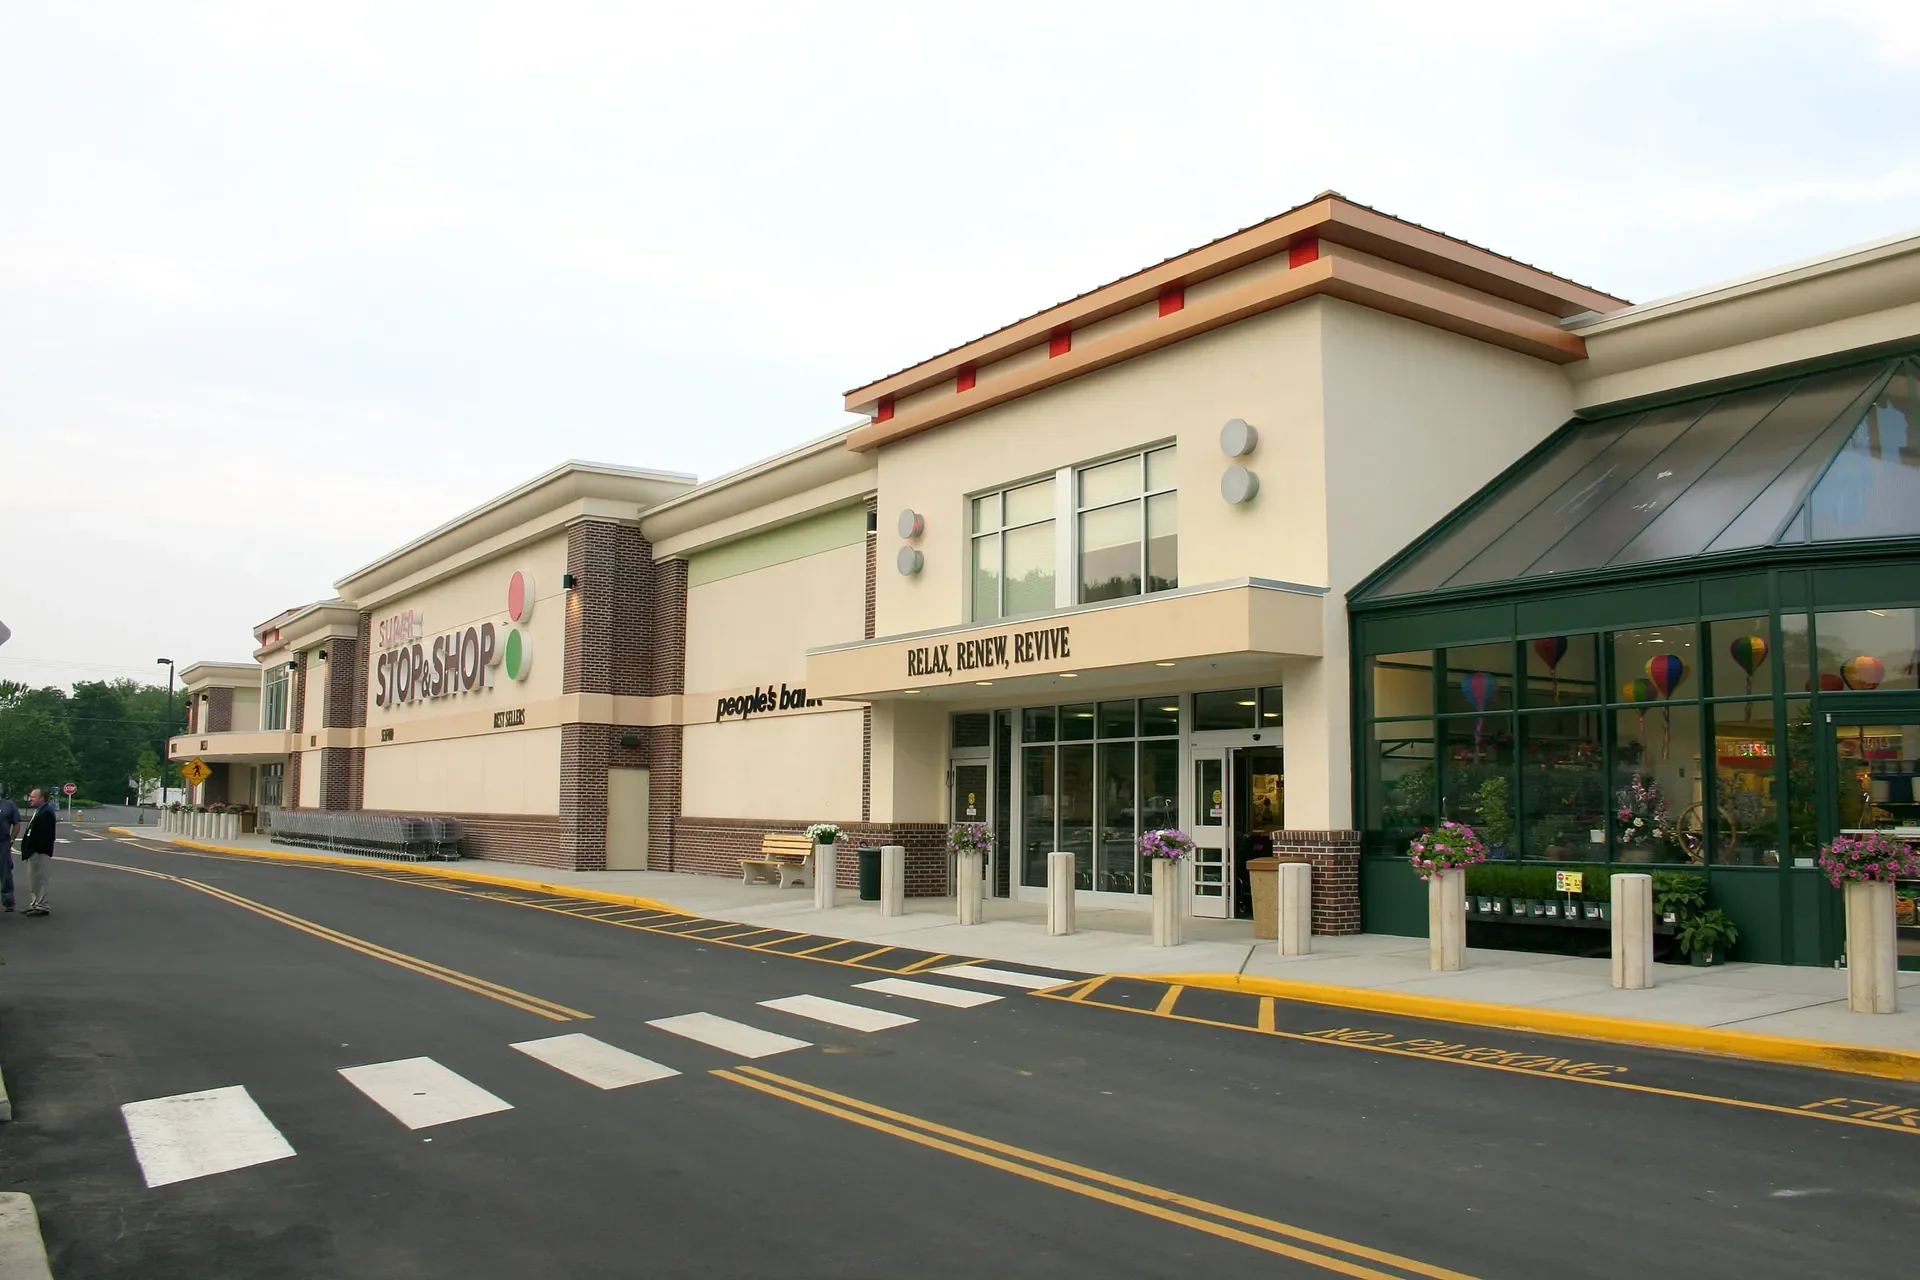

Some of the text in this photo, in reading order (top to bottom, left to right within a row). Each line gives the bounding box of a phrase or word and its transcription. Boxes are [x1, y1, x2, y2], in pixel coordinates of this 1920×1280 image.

[379, 609, 415, 647] SUPER
[907, 626, 1070, 677] RELAX, RENEW, REVIVE
[715, 685, 777, 723] people's
[1303, 1027, 1629, 1077] NO PARKING
